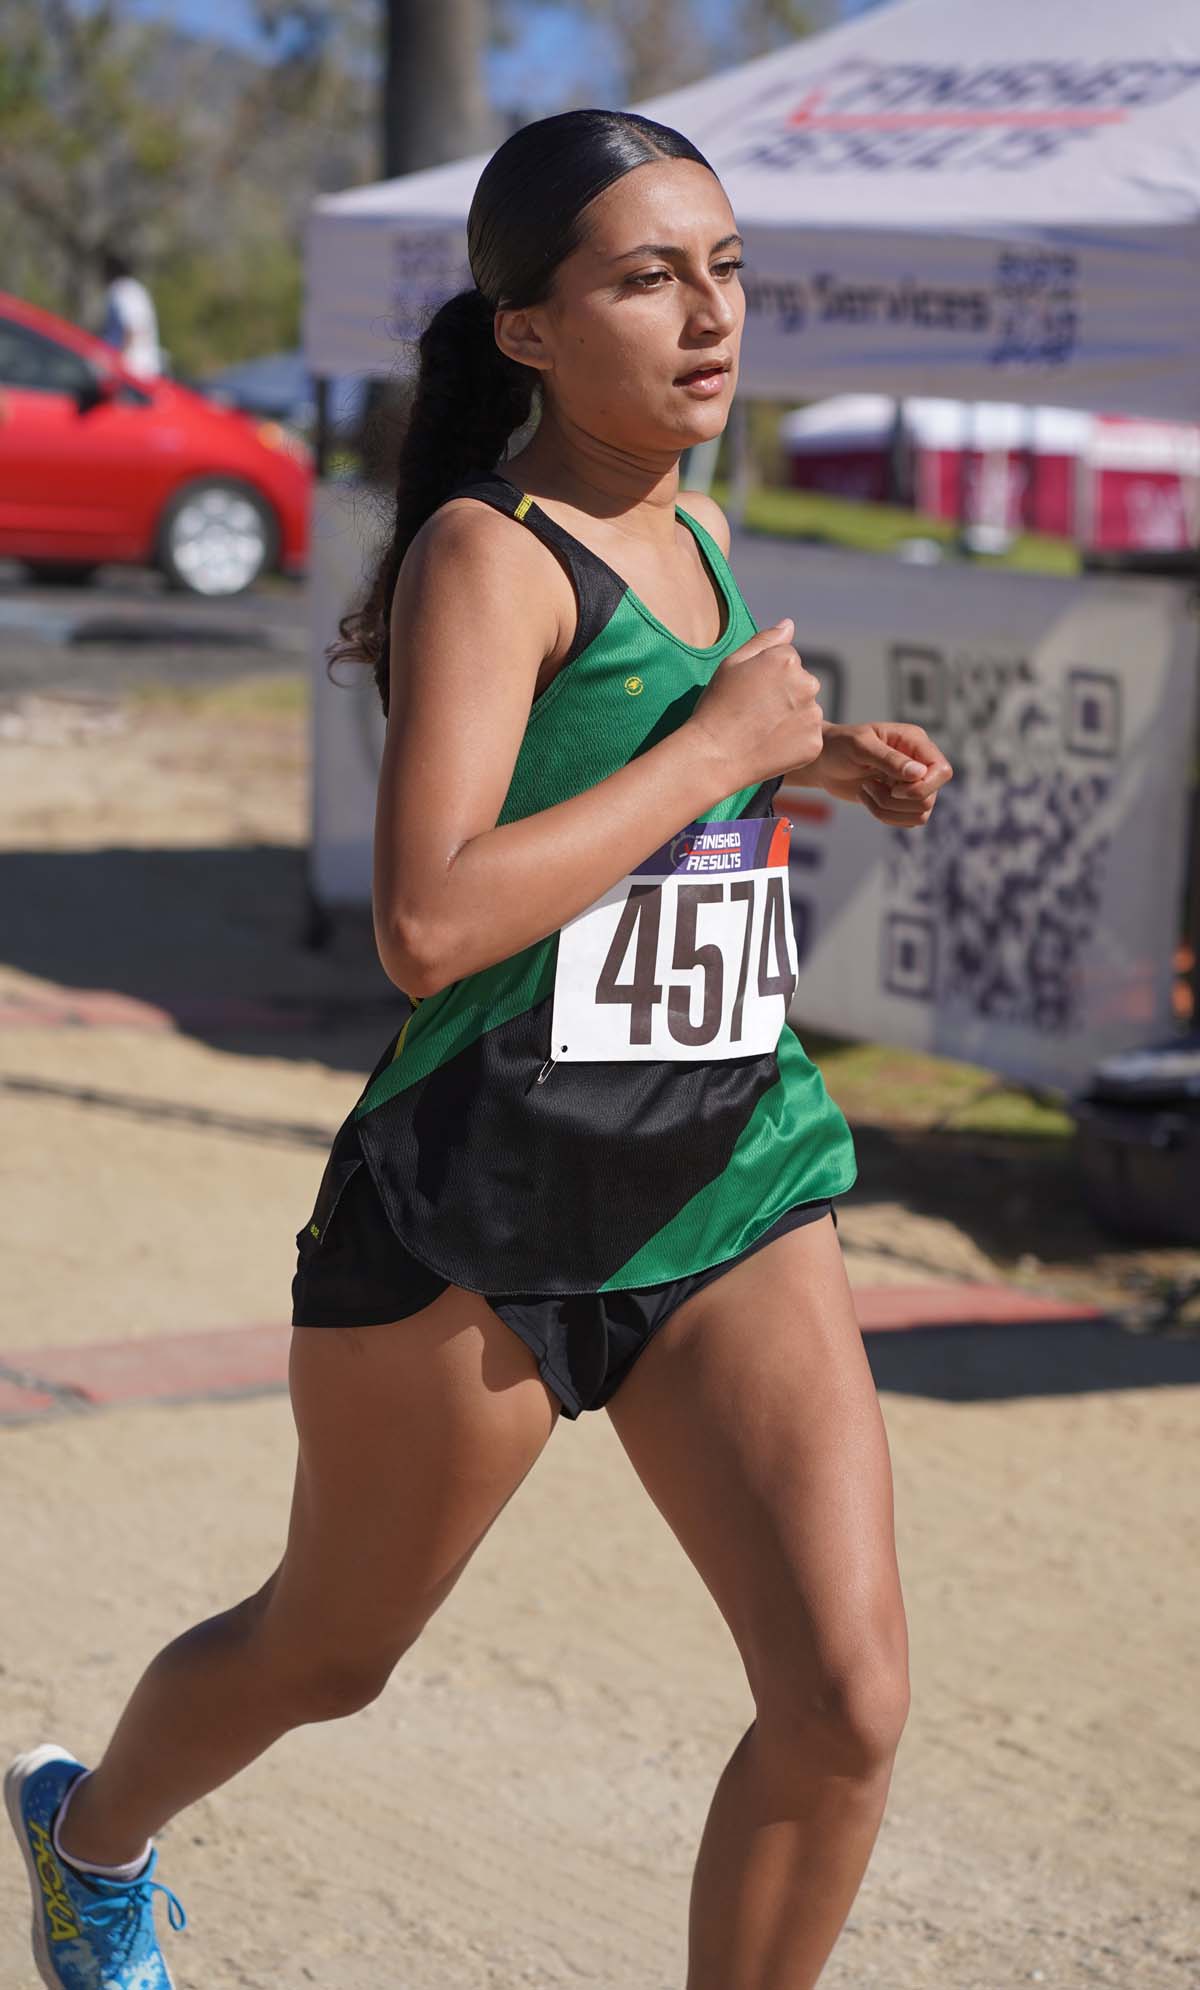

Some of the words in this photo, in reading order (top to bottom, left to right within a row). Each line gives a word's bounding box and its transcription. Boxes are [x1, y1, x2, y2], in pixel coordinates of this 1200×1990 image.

[686, 853, 741, 870] RESULTS
[692, 832, 741, 850] FINISHED
[595, 876, 797, 1047] 4574
[29, 1820, 79, 1941] HOKA
